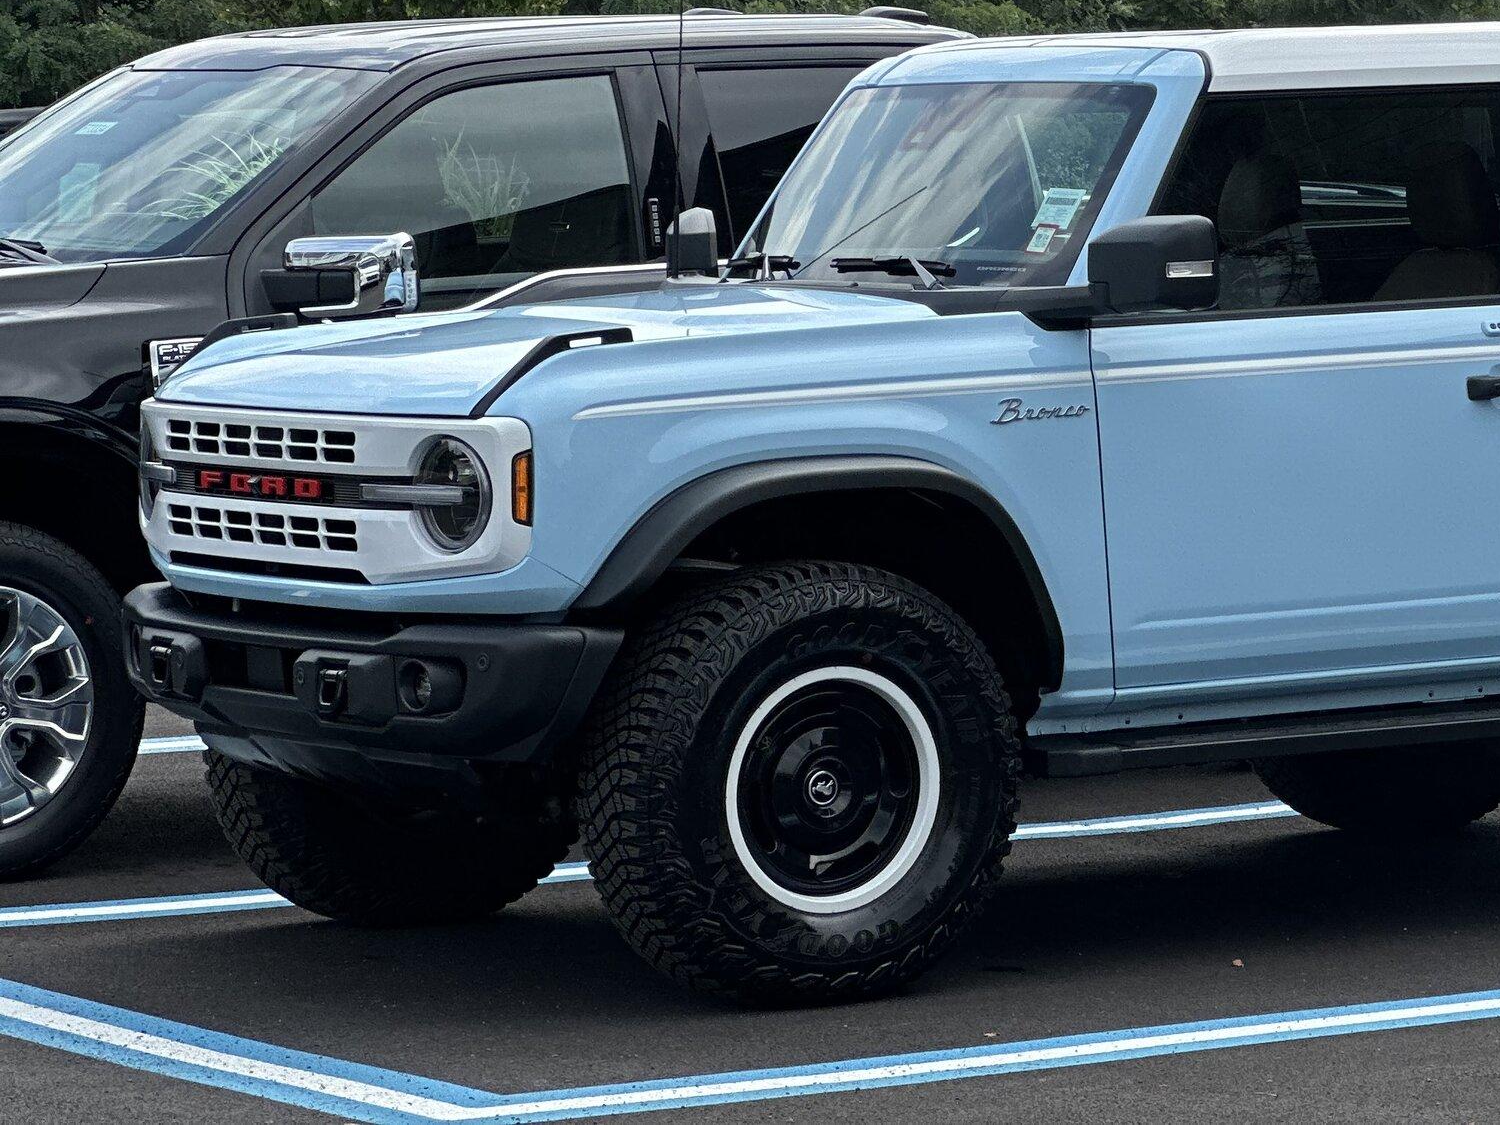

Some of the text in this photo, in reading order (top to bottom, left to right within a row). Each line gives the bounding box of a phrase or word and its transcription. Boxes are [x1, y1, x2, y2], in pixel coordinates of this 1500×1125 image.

[158, 342, 199, 355] F-15
[990, 397, 1090, 424] Bronco
[200, 470, 321, 498] FORD
